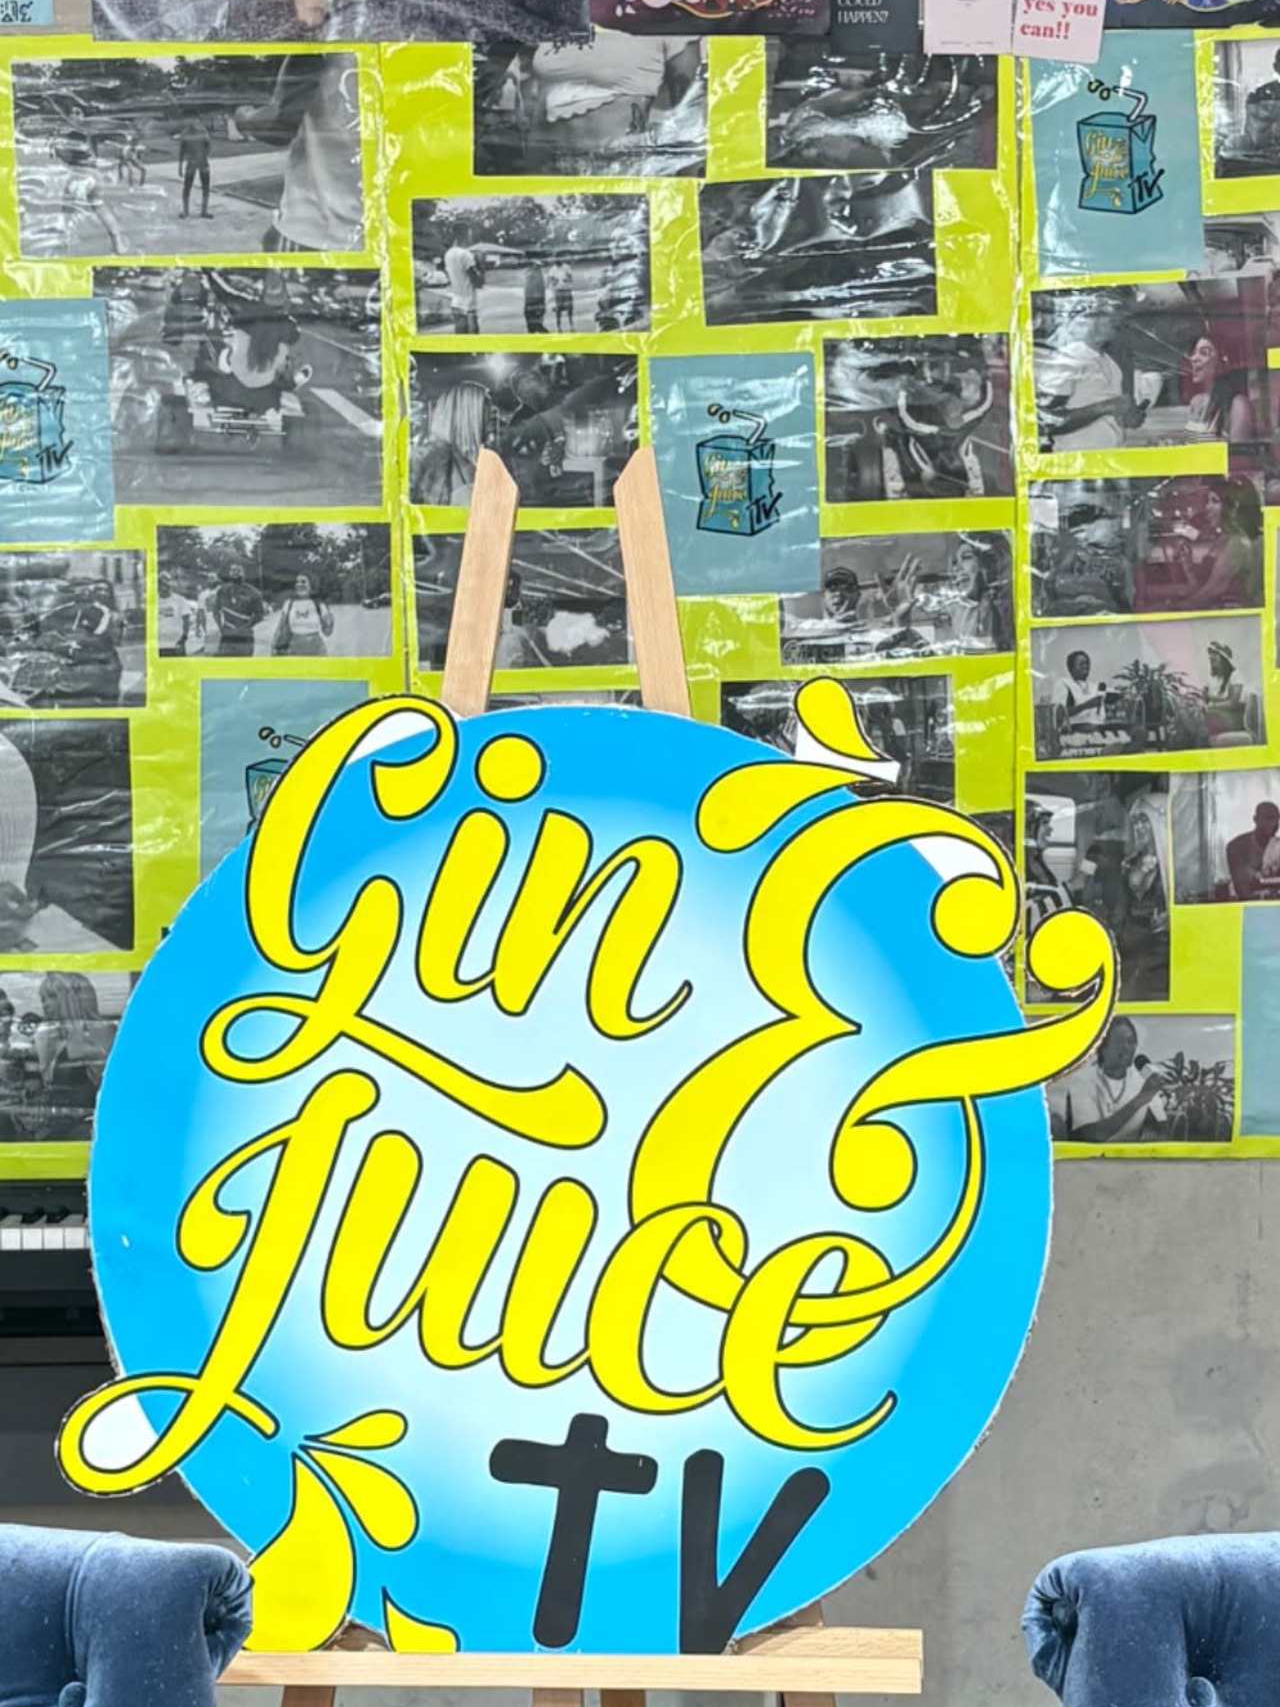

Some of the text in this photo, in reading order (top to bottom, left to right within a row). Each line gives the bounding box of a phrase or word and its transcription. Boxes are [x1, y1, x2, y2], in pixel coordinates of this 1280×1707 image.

[837, 10, 890, 24] HAPPEN?
[1062, 0, 1099, 19] you
[1019, 21, 1071, 40] can!!
[1127, 168, 1165, 204] TV
[35, 439, 74, 473] TV
[746, 491, 783, 525] TV
[200, 695, 1120, 1328] Gin &
[56, 1068, 898, 1496] Juice
[488, 1411, 832, 1654] TV
